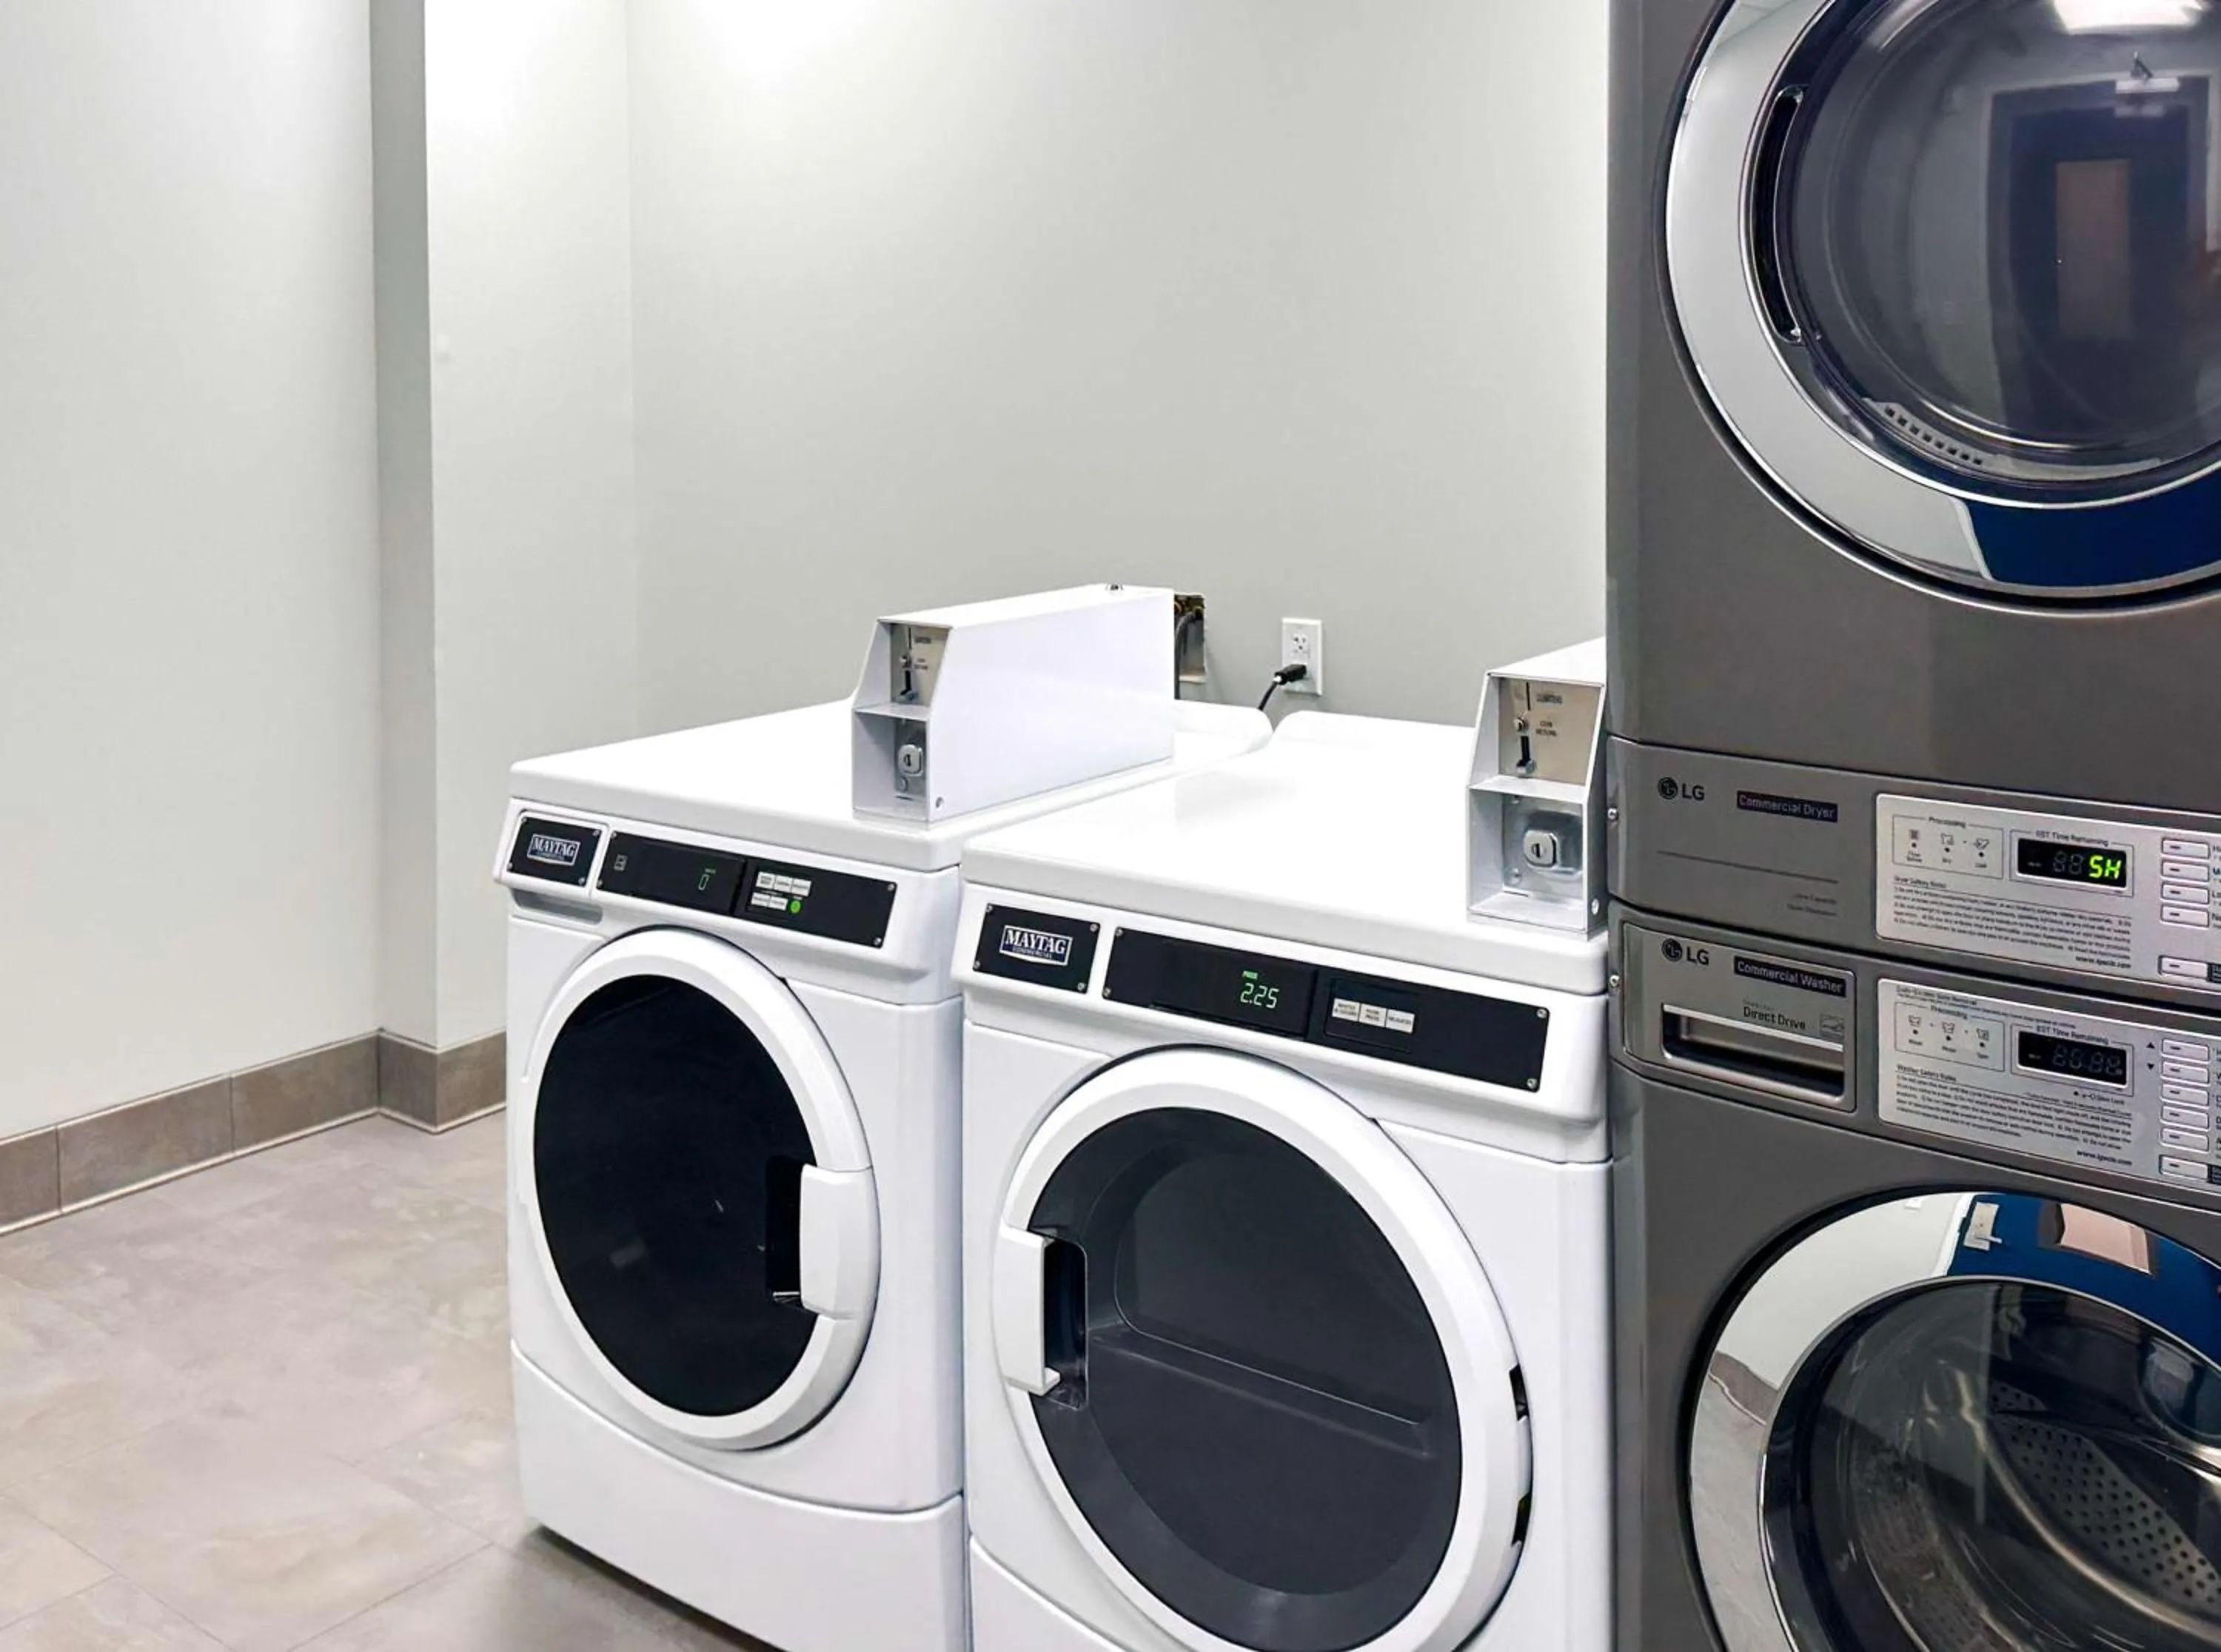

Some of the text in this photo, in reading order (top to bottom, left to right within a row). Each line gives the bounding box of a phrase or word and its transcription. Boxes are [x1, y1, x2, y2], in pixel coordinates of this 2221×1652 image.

[1681, 782, 1706, 801] LG
[1739, 794, 1836, 819] Commercial Dryer
[533, 837, 575, 856] MAYTAG
[1005, 929, 1066, 954] MAYTAG
[1686, 946, 1709, 966] LG
[1737, 961, 1843, 993] Commercial Washer
[1240, 982, 1279, 1009] 2.25
[1743, 1006, 1806, 1031] Direct Drive
